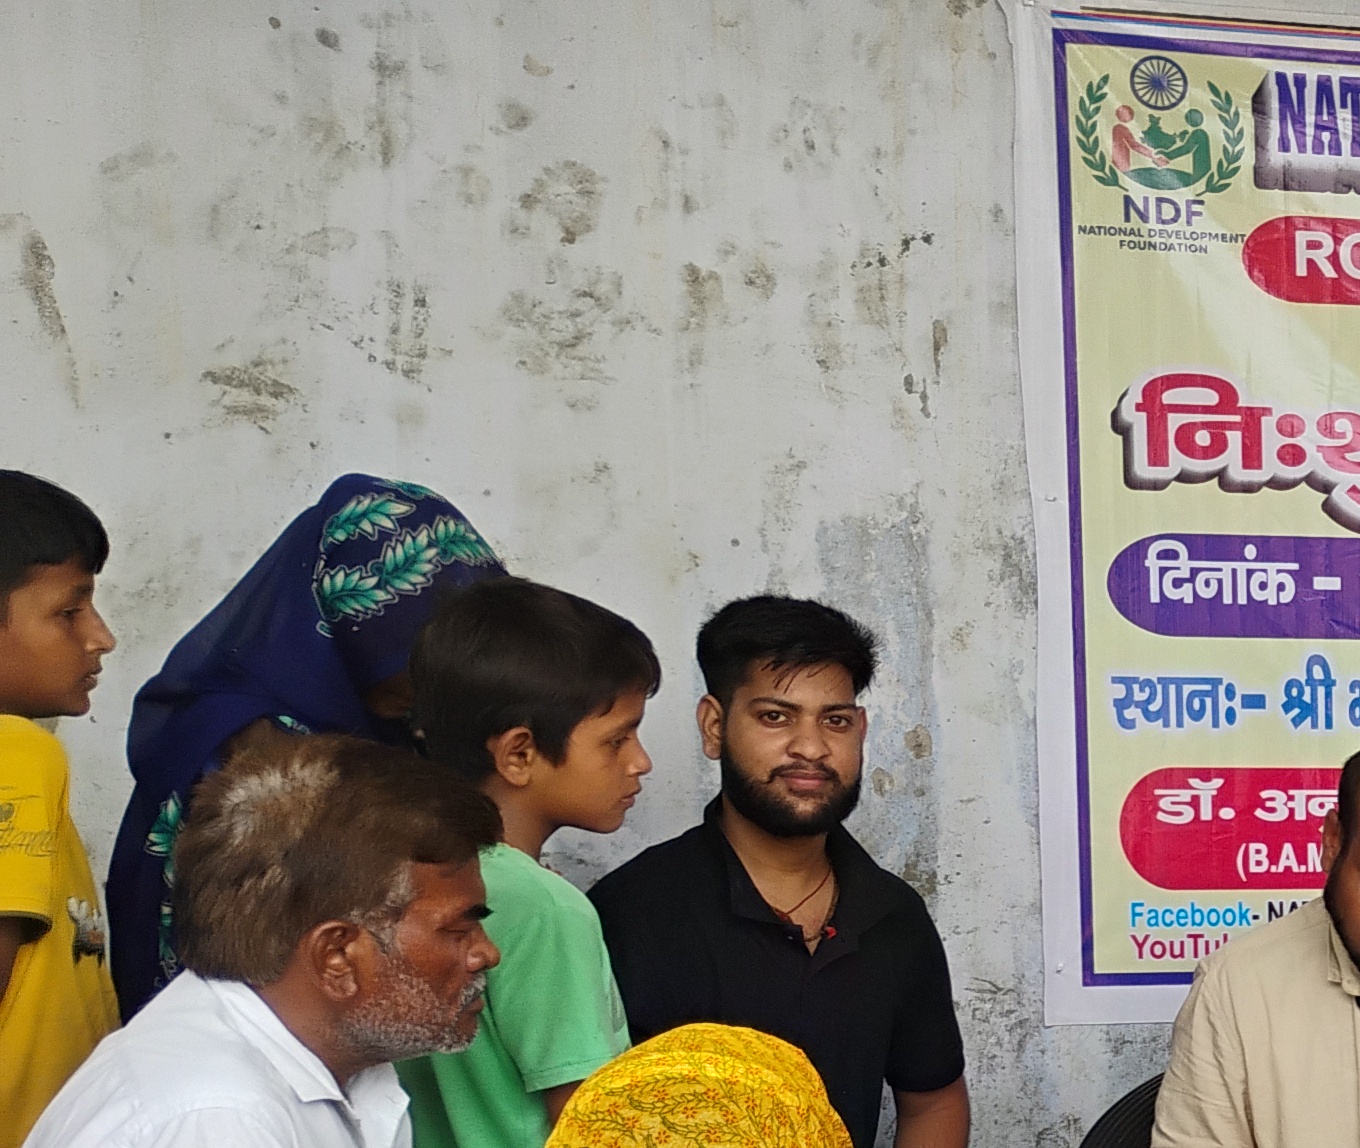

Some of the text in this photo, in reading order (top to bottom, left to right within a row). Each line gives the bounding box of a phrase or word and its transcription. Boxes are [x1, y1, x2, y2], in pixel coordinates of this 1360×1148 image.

[1123, 194, 1206, 227] NDF
[1077, 225, 1247, 244] NATIONAL DEVELOPMENT
[1119, 240, 1208, 254] FOUNDATION
[1145, 540, 1299, 606] दिनांक
[1281, 654, 1336, 731] श्री
[1154, 778, 1236, 824] डॉ.
